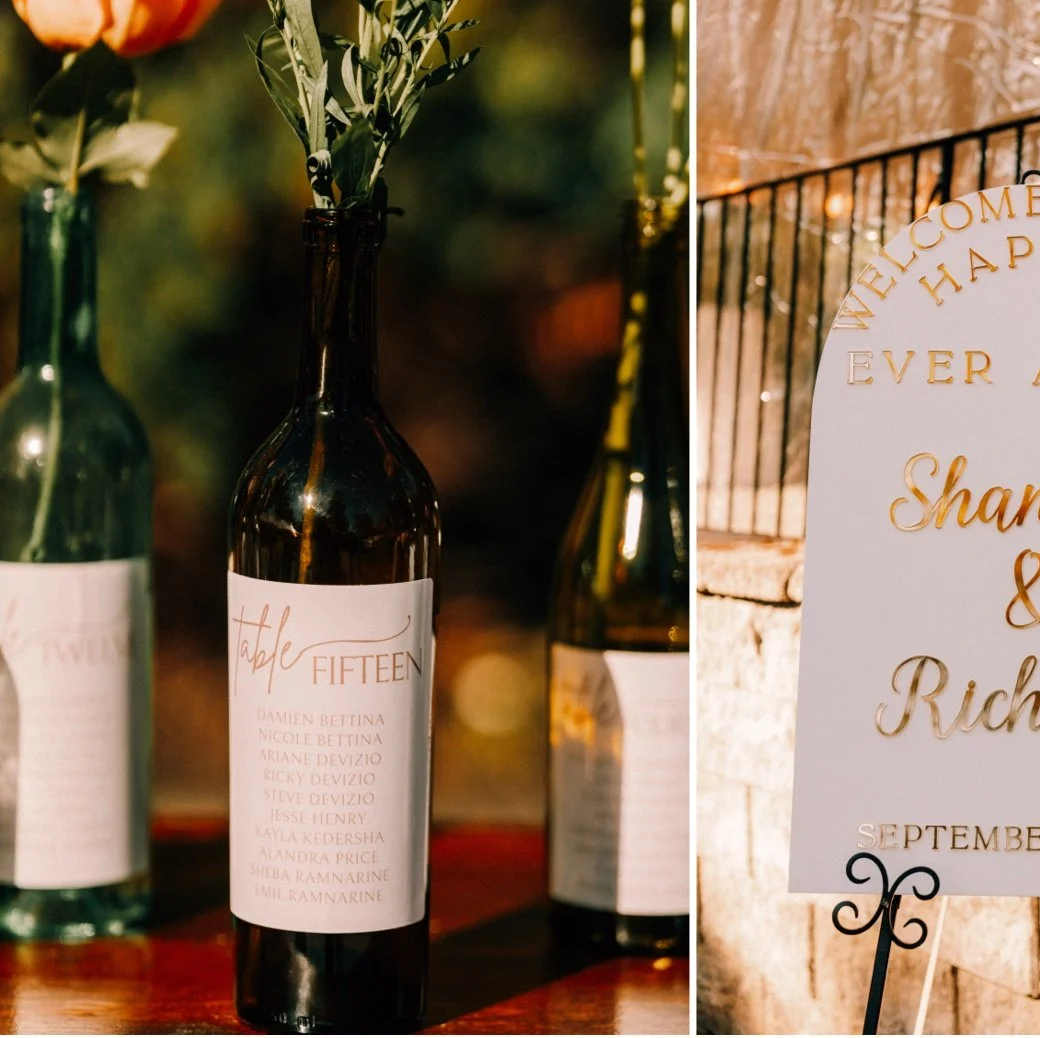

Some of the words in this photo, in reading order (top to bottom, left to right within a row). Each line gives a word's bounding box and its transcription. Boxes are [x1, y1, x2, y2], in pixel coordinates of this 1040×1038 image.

[846, 350, 993, 386] EVER
[312, 647, 423, 685] FIFTEEN
[257, 708, 314, 726] DAMIEN
[320, 713, 385, 727] BETTINA
[258, 728, 312, 746] NICOLE
[317, 733, 383, 747] BETTINA
[259, 748, 312, 766] ARIANE
[317, 752, 382, 766] DEVIZIO
[263, 768, 305, 784] RICKY
[311, 772, 376, 786] DEVIZIO
[263, 788, 304, 805] STEVE
[309, 792, 375, 806] DEVIZIO
[270, 808, 307, 824] JESSE
[313, 812, 367, 825] HENRY
[255, 825, 298, 843] KAYLA
[303, 831, 385, 845] KEDERSHA
[259, 846, 330, 865] ALANDRA
[336, 850, 380, 865] PRICE
[249, 862, 291, 882] SHEBA
[296, 868, 391, 884] RAMNARINE
[254, 883, 285, 901] EMIL
[288, 889, 384, 904] RAMNARINE
